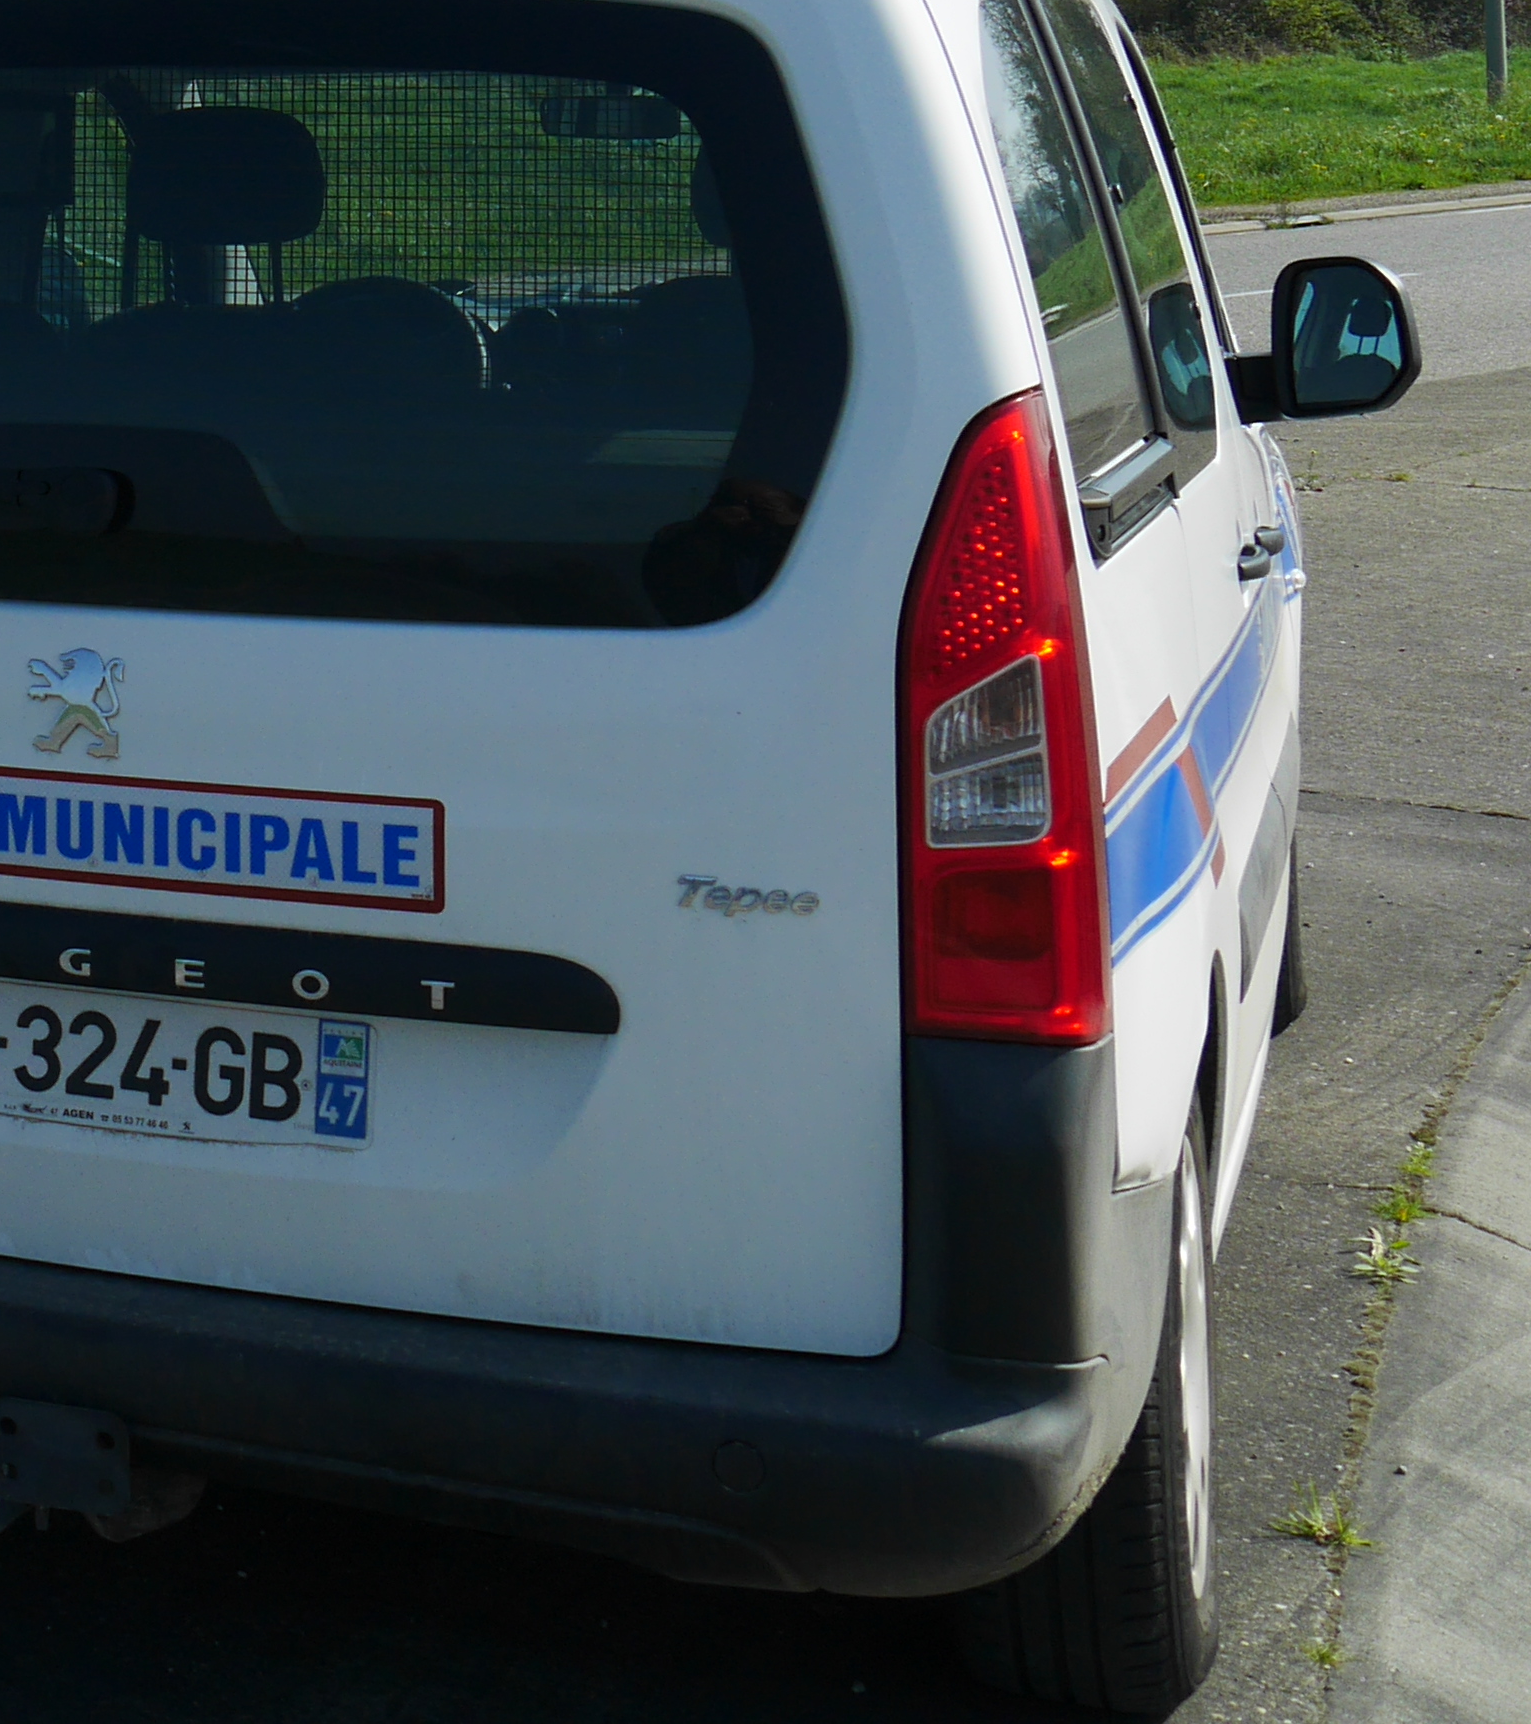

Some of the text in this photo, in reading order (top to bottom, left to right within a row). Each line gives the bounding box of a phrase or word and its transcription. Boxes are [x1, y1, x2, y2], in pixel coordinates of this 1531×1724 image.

[677, 874, 820, 917] Tepee
[322, 1059, 363, 1069] AQUITAINE
[62, 1108, 94, 1120] AGEN
[319, 1082, 365, 1127] 47
